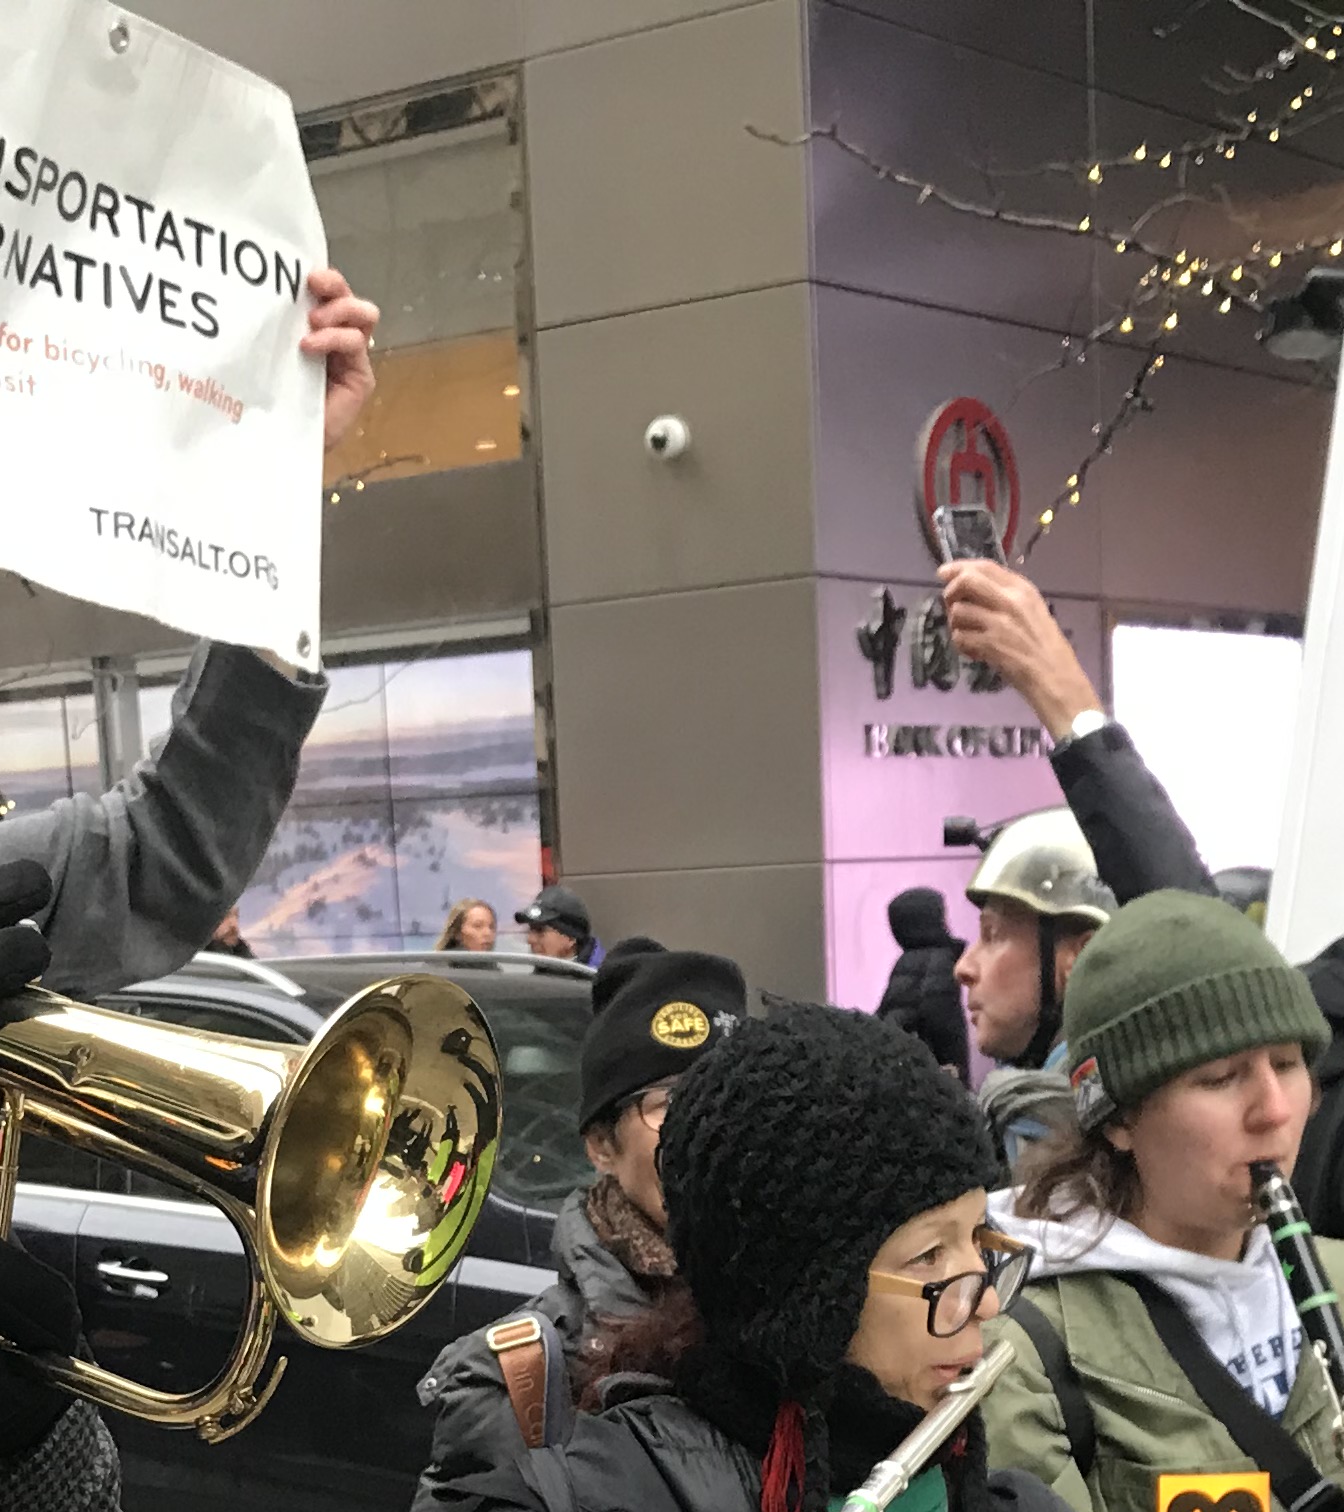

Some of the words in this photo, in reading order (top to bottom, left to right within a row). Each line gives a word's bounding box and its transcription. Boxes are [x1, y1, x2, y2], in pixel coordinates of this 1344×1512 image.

[44, 335, 171, 392] bicycling,
[177, 370, 244, 424] walking
[89, 507, 278, 590] TRANSALT.ORG
[657, 1018, 706, 1035] SAFE
